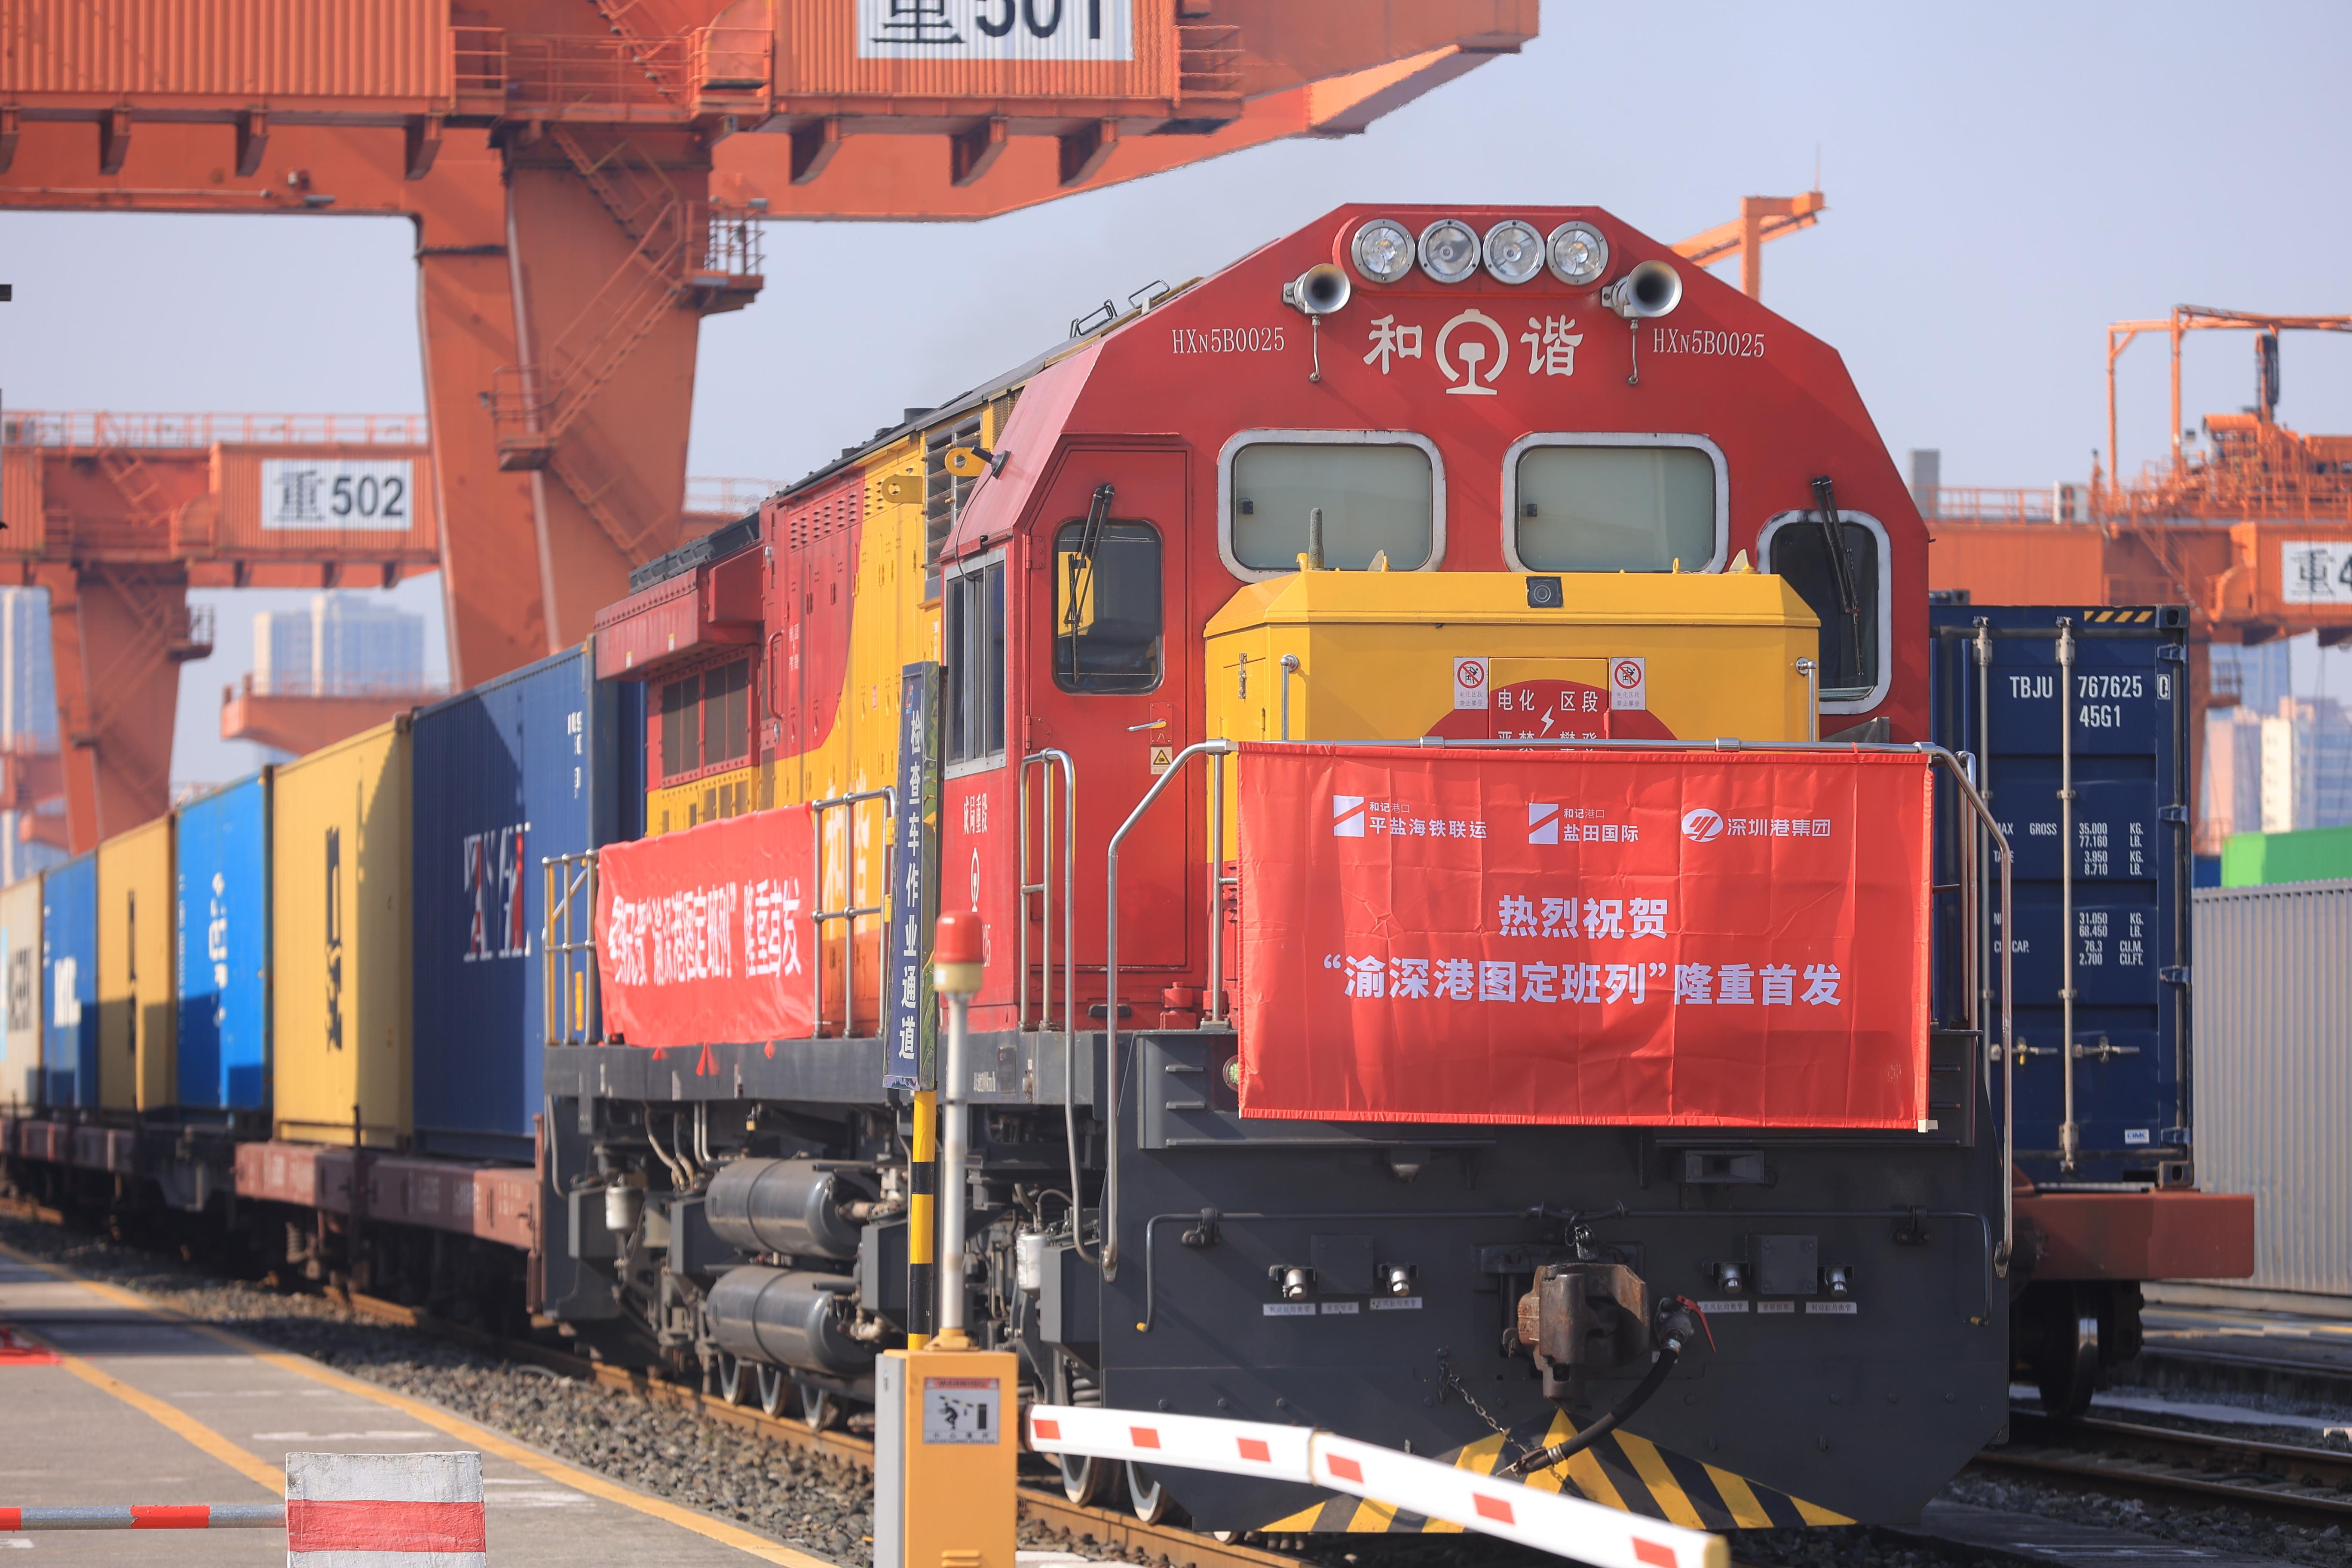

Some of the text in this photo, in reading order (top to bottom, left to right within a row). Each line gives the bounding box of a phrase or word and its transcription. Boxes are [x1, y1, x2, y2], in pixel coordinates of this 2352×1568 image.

[1363, 314, 1584, 377] 和 谐
[272, 469, 404, 522] 重502
[2009, 675, 2053, 698] TBJU
[2077, 675, 2143, 698] 767625
[2079, 704, 2121, 728] 45G1
[1369, 801, 1410, 814] 和记港口
[1563, 808, 1605, 819] 和记港口
[1369, 817, 1487, 839] 平盐海铁联运
[1563, 824, 1639, 842] 盐田国际
[1727, 818, 1831, 837] 深圳港集团
[2029, 822, 2057, 835] GROSS
[2079, 822, 2108, 835] 35.000
[2129, 822, 2144, 835] KG.
[2079, 835, 2142, 848] 77.160 LB.
[1993, 850, 2144, 863] TAE 3.950 KG.
[2084, 863, 2142, 876] 8.710 LB.
[1498, 894, 1669, 940] 热烈祝贺
[2079, 912, 2144, 925] 31.050 KG.
[2079, 925, 2142, 937] 68.450 LB.
[2012, 940, 2030, 953] CAP.
[2084, 940, 2103, 952] 76.3
[2079, 952, 2103, 965] 2.700
[1323, 953, 1842, 1006] “渝深港图定班列”隆重首发
